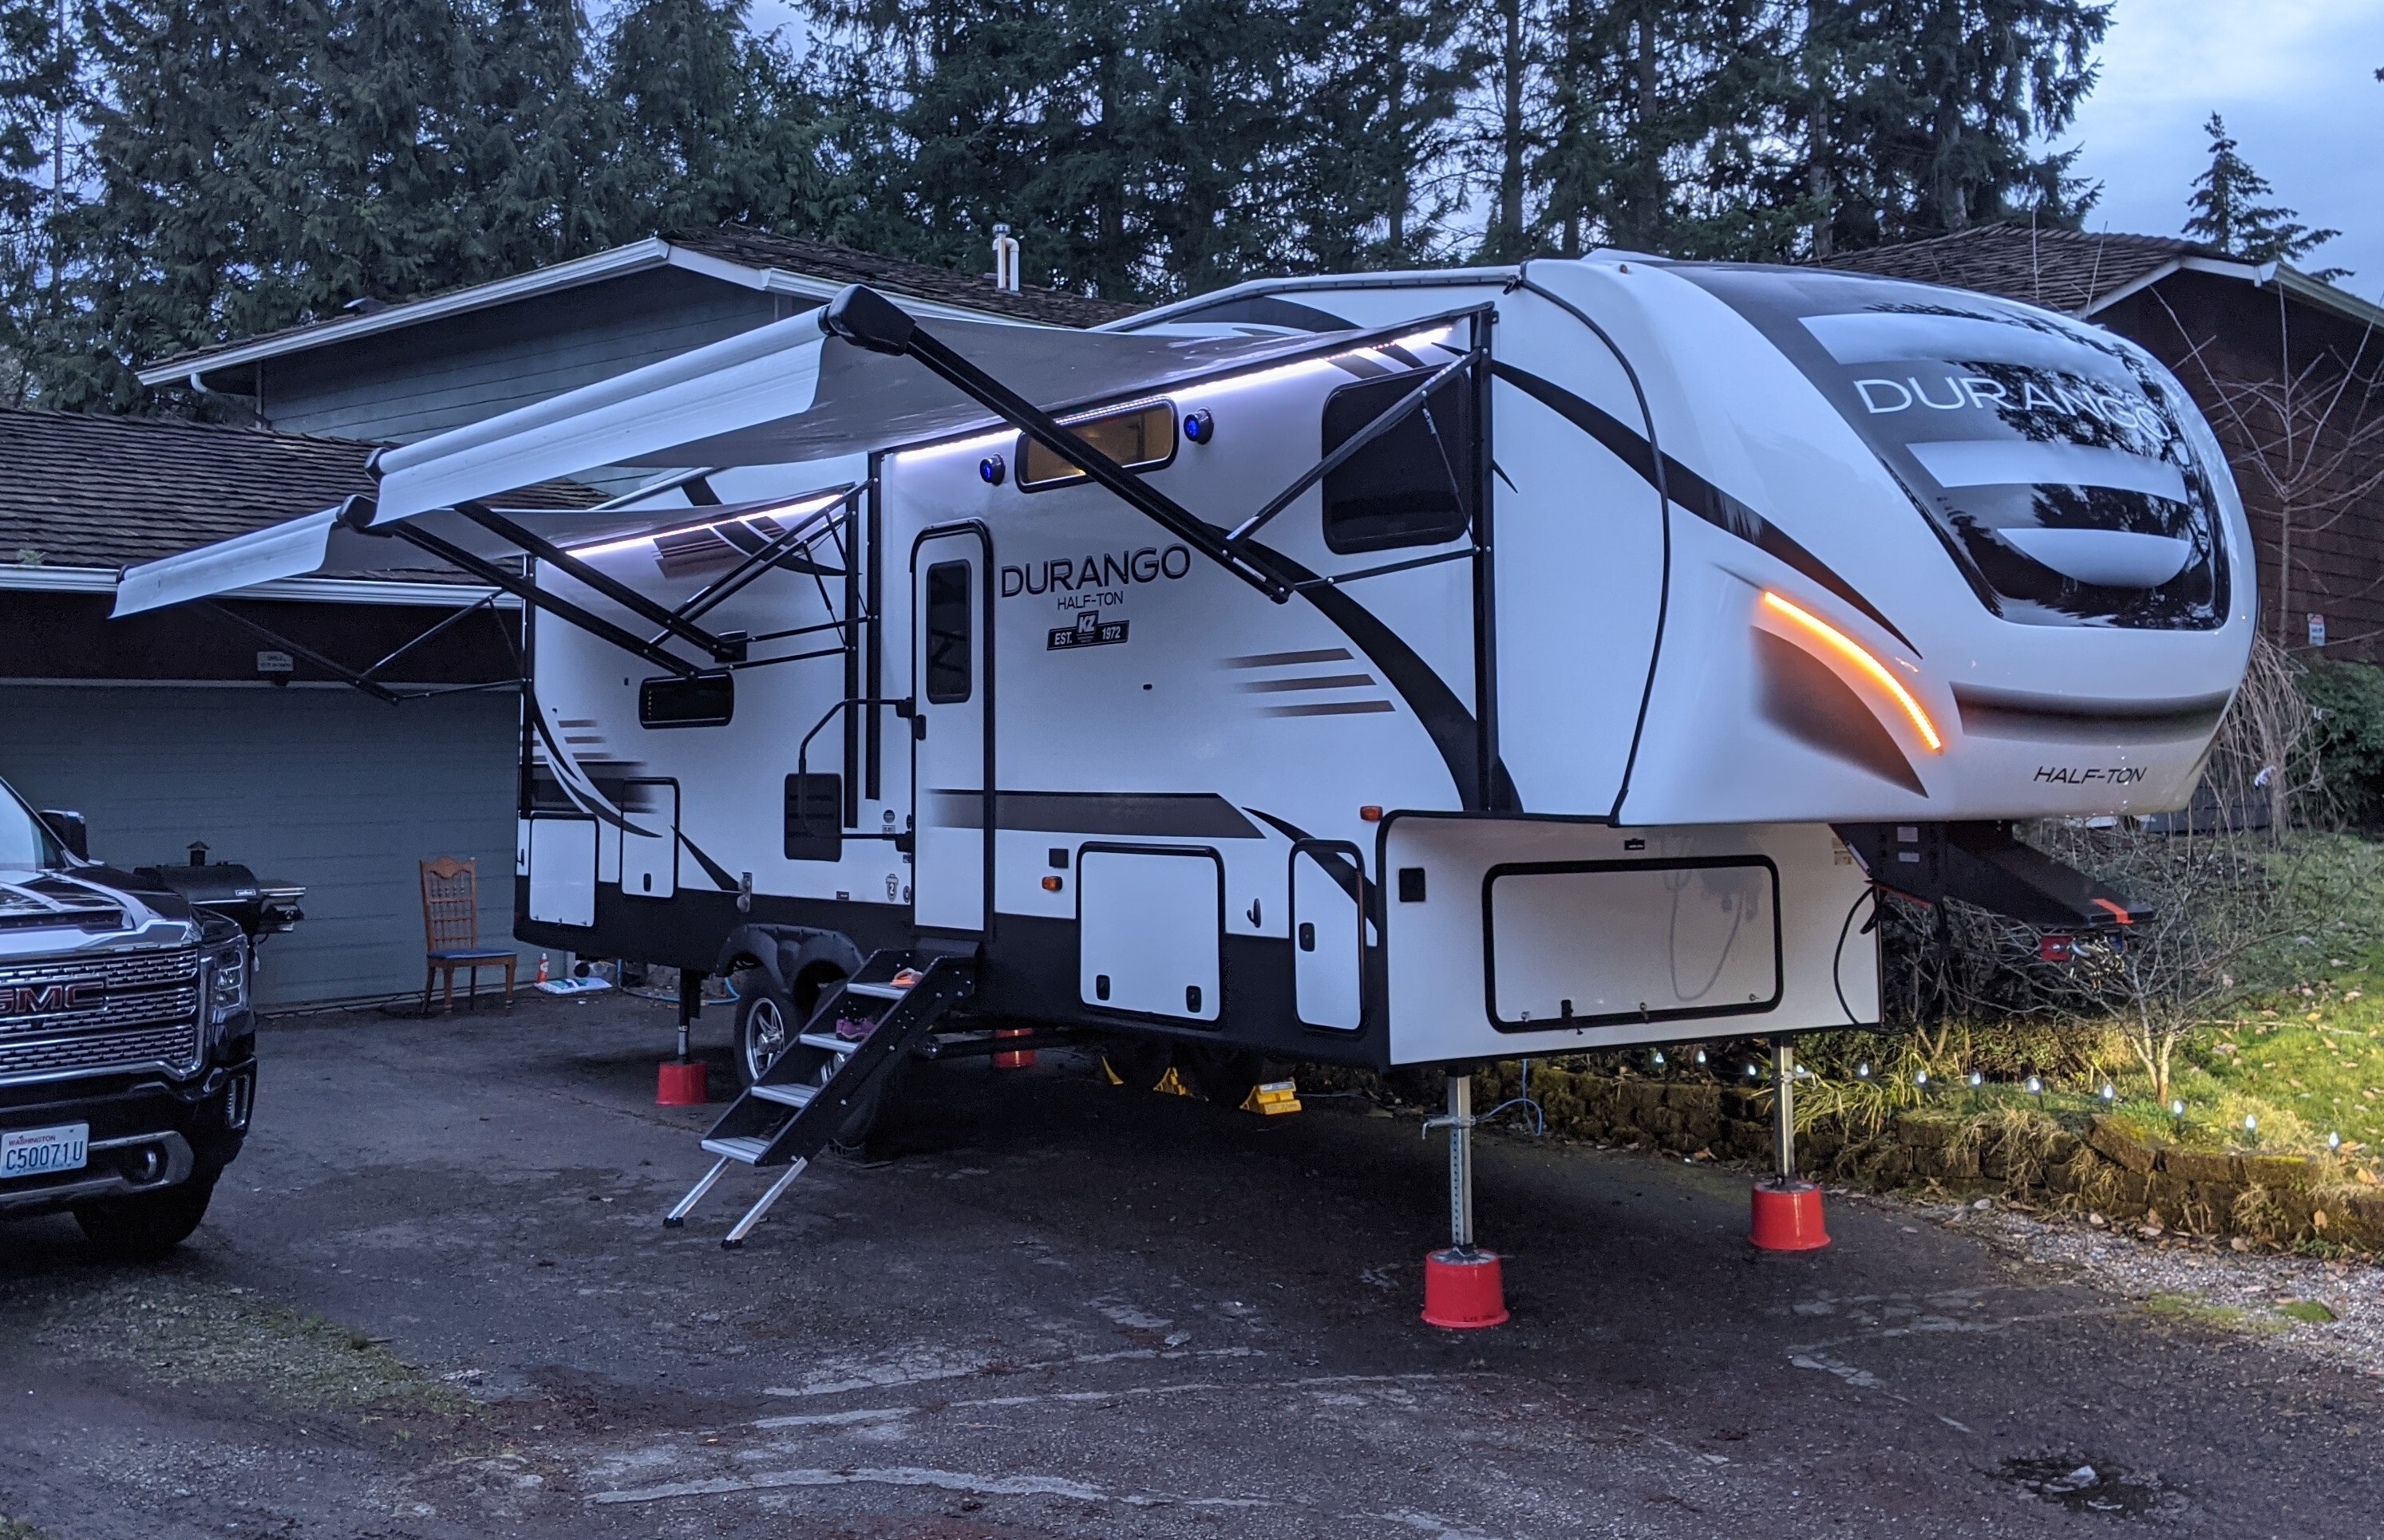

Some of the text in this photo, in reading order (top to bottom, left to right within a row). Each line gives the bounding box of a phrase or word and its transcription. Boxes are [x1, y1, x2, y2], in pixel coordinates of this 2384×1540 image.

[1853, 376, 2172, 441] DURANGO
[1001, 543, 1191, 598] DURANGO
[1057, 590, 1124, 610] HALF-TON
[1078, 614, 1097, 634] KZ
[1054, 626, 1121, 646] EST. 1972
[2033, 766, 2148, 784] HALF-TON
[8, 1135, 56, 1146] WASHINGTON
[6, 1140, 83, 1171] C50071U
